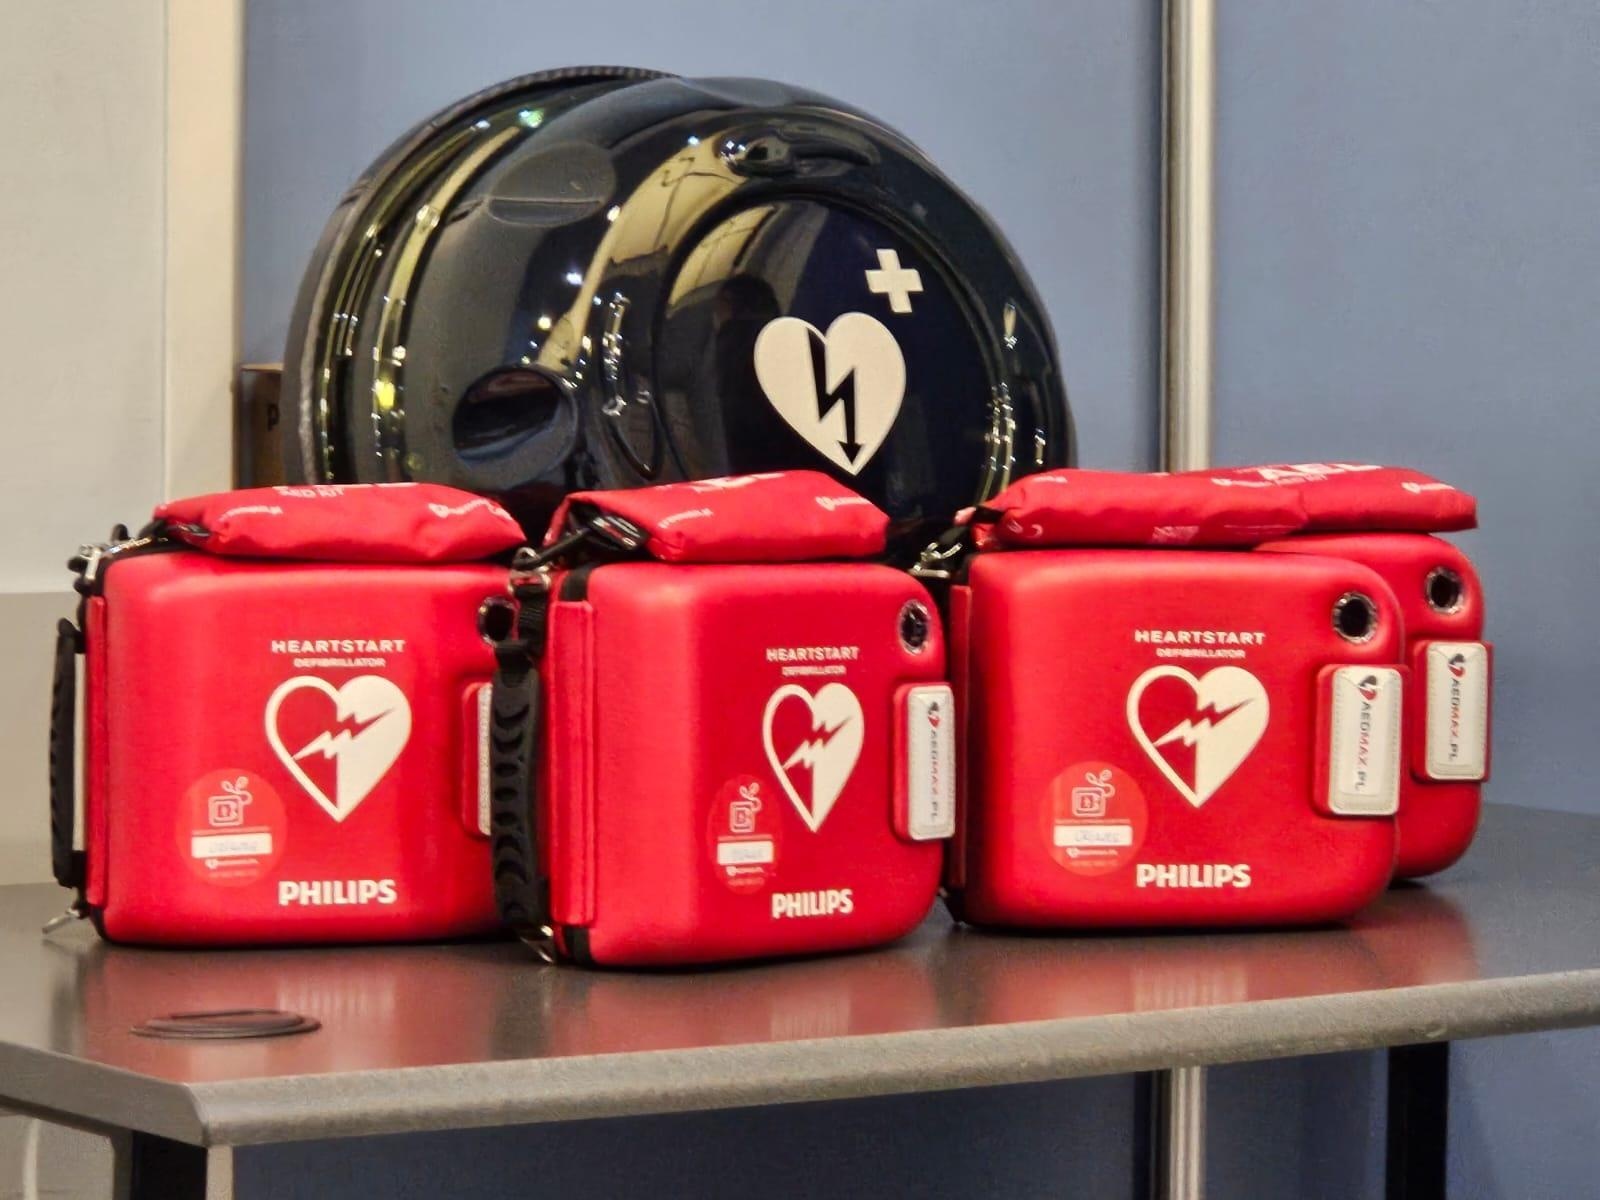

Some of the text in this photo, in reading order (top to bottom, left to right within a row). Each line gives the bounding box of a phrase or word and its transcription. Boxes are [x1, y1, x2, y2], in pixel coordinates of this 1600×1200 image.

[271, 639, 406, 654] HEARTSTART
[1134, 629, 1267, 645] HEARTSTART
[765, 646, 860, 662] HEARTSTART
[1136, 863, 1252, 889] PHILIPS
[278, 878, 398, 907] PHILIPS
[772, 888, 853, 919] PHILIPS
